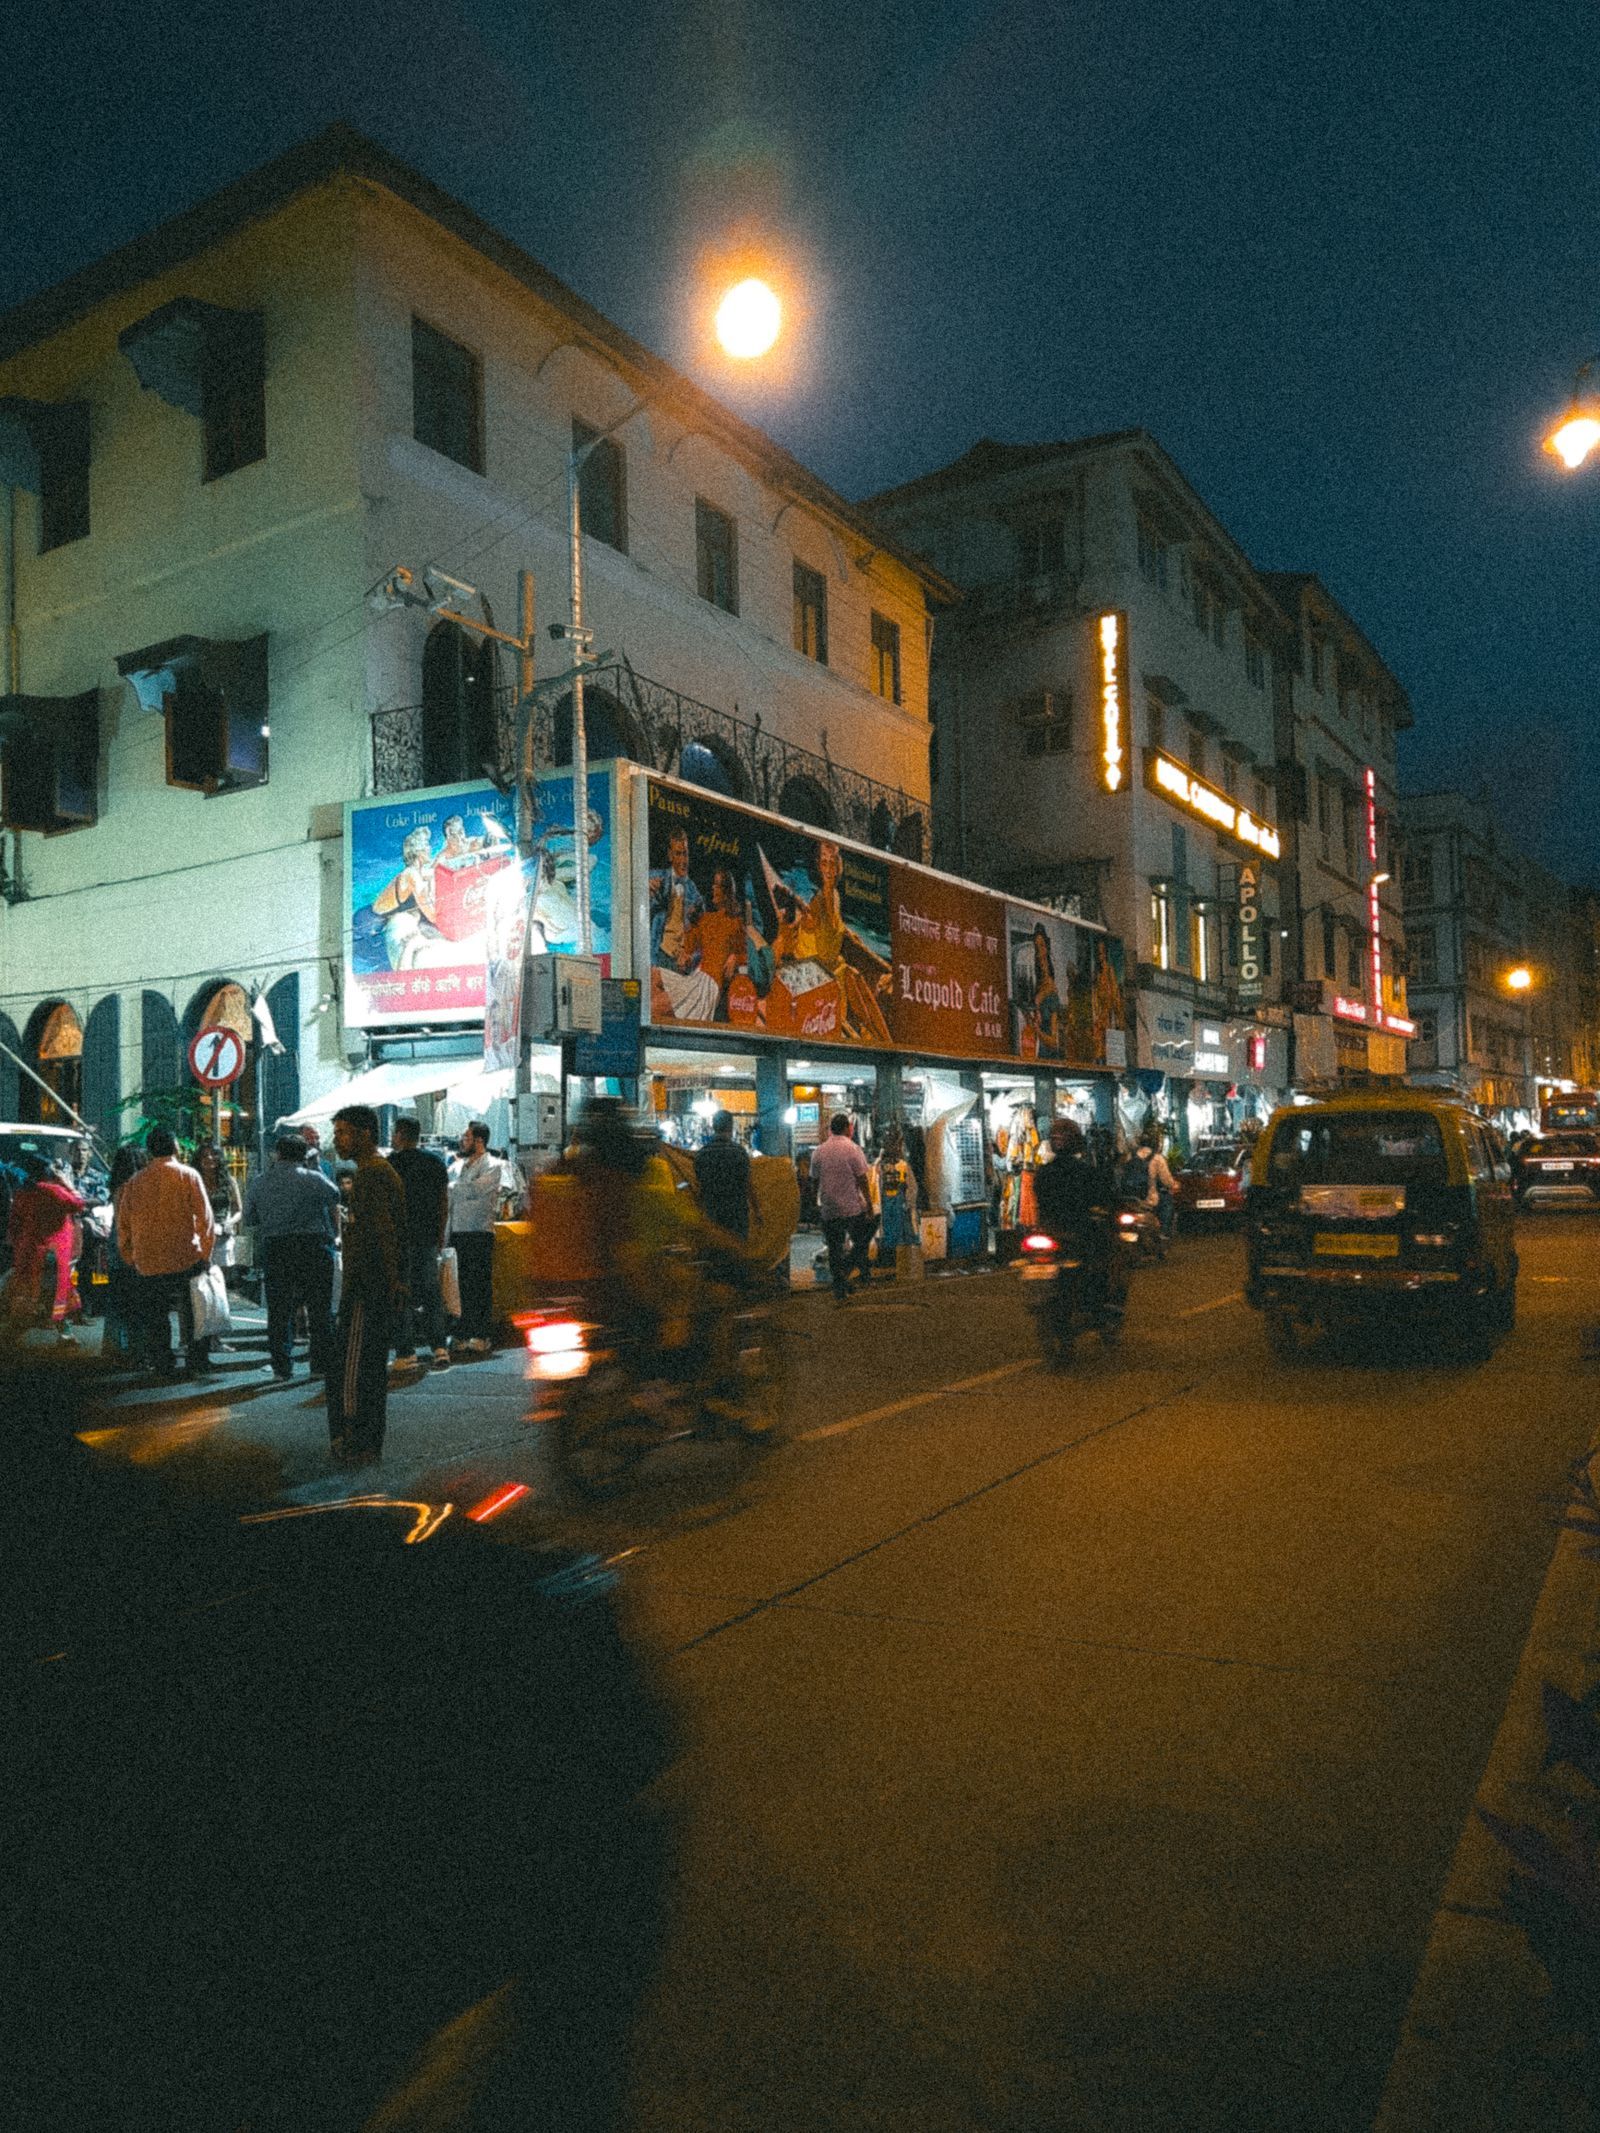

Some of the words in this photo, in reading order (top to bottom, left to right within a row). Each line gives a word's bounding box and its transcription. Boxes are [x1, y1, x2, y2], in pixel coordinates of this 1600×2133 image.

[649, 784, 691, 818] Pause
[384, 813, 410, 829] Coke
[410, 810, 438, 826] Time
[696, 831, 741, 857] refresh
[1239, 867, 1259, 980] APOLLO
[899, 964, 964, 1011] Leopold
[984, 1022, 1003, 1039] BAR
